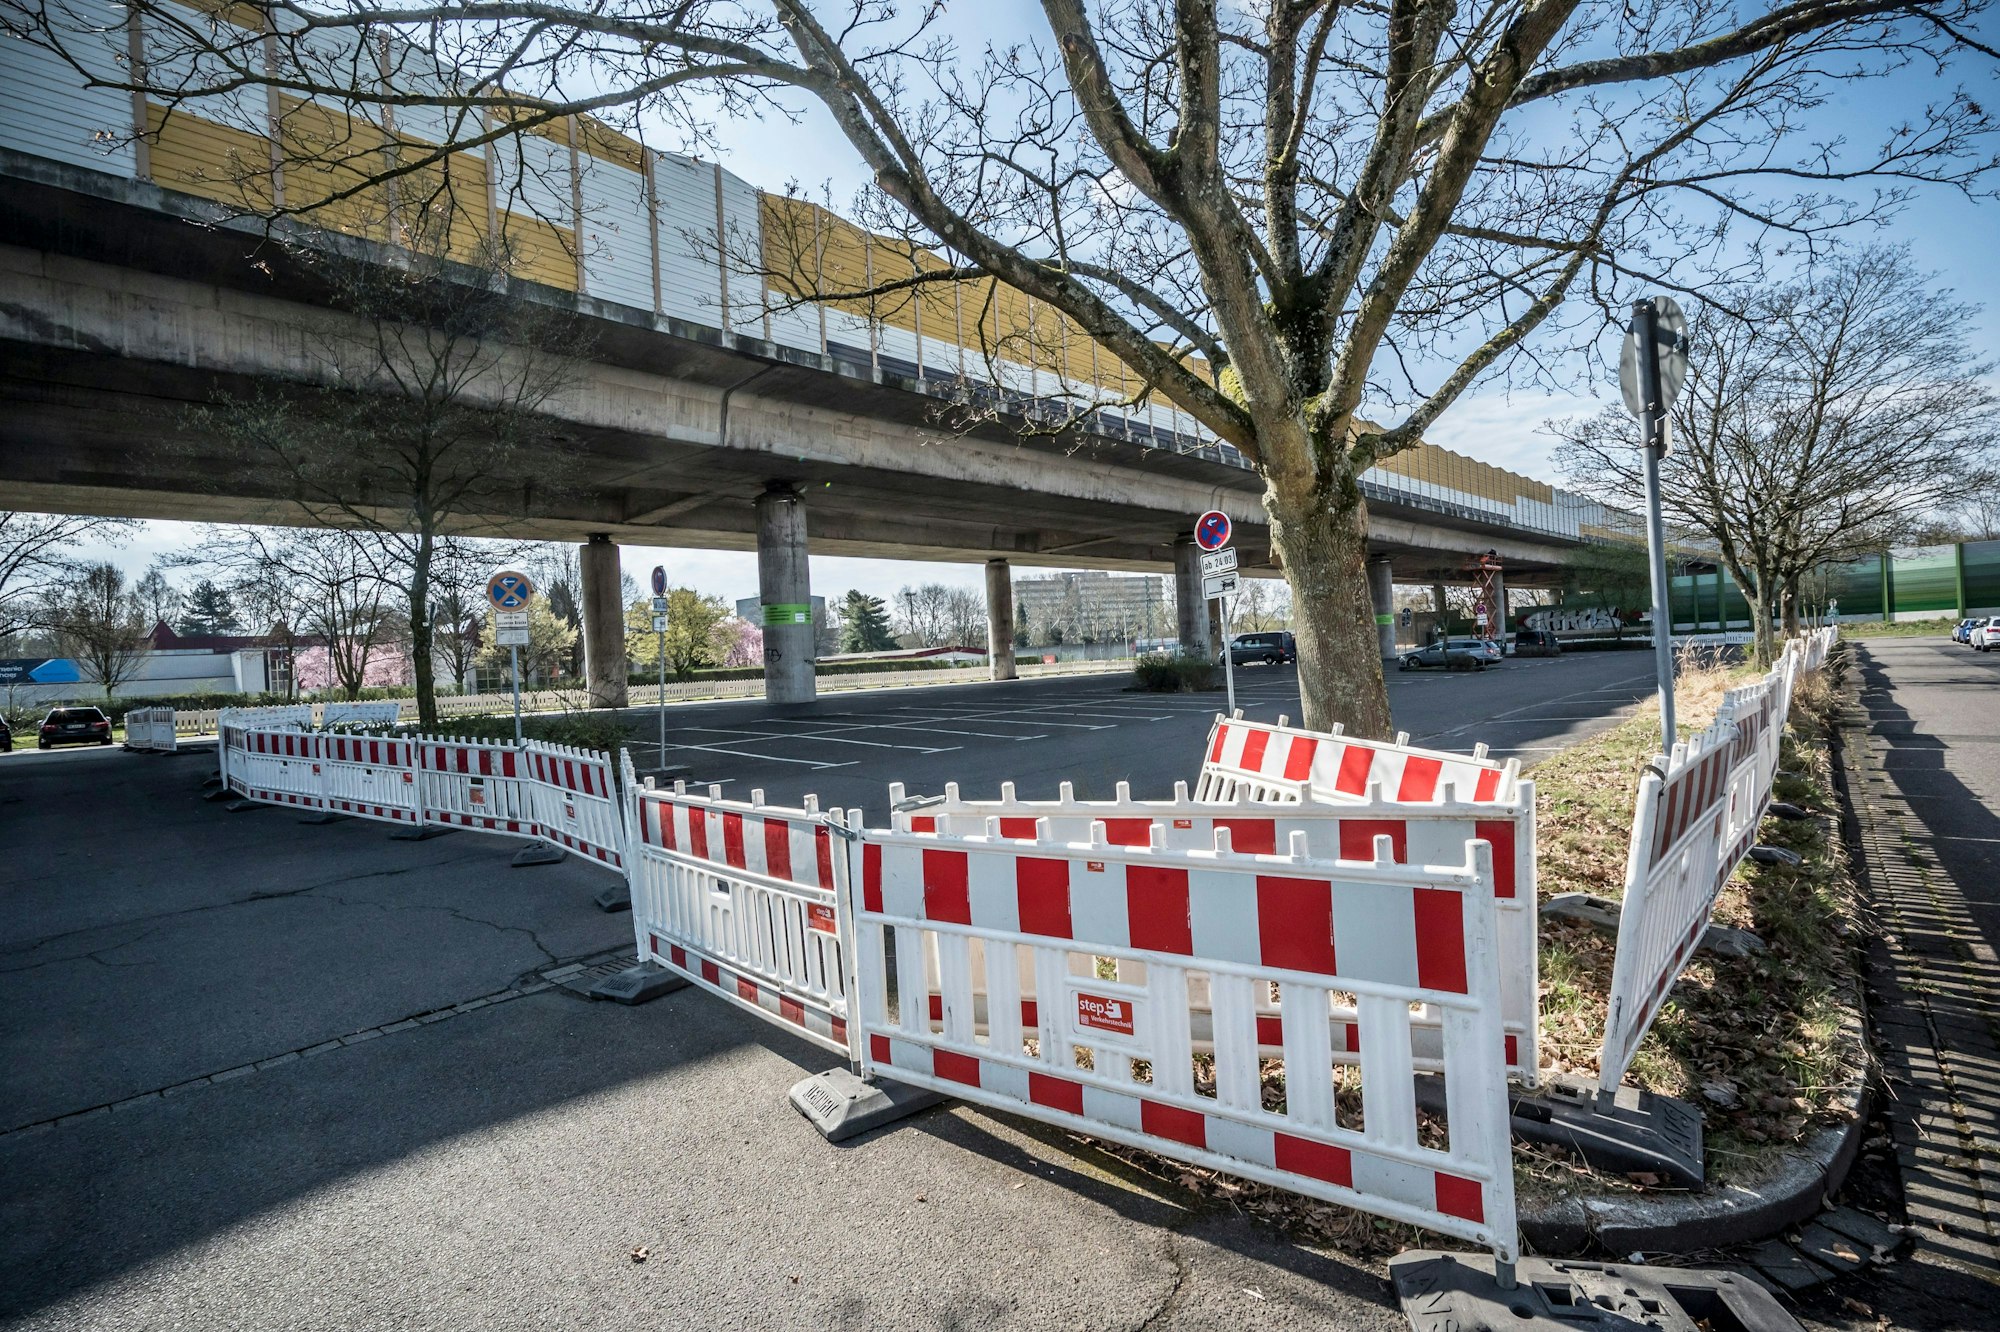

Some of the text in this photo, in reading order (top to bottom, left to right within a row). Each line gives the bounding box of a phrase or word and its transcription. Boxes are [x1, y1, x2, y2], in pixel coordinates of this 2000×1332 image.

[1204, 560, 1213, 571] ab
[1079, 999, 1105, 1016] step
[1090, 1014, 1133, 1029] Verkehrstechnik
